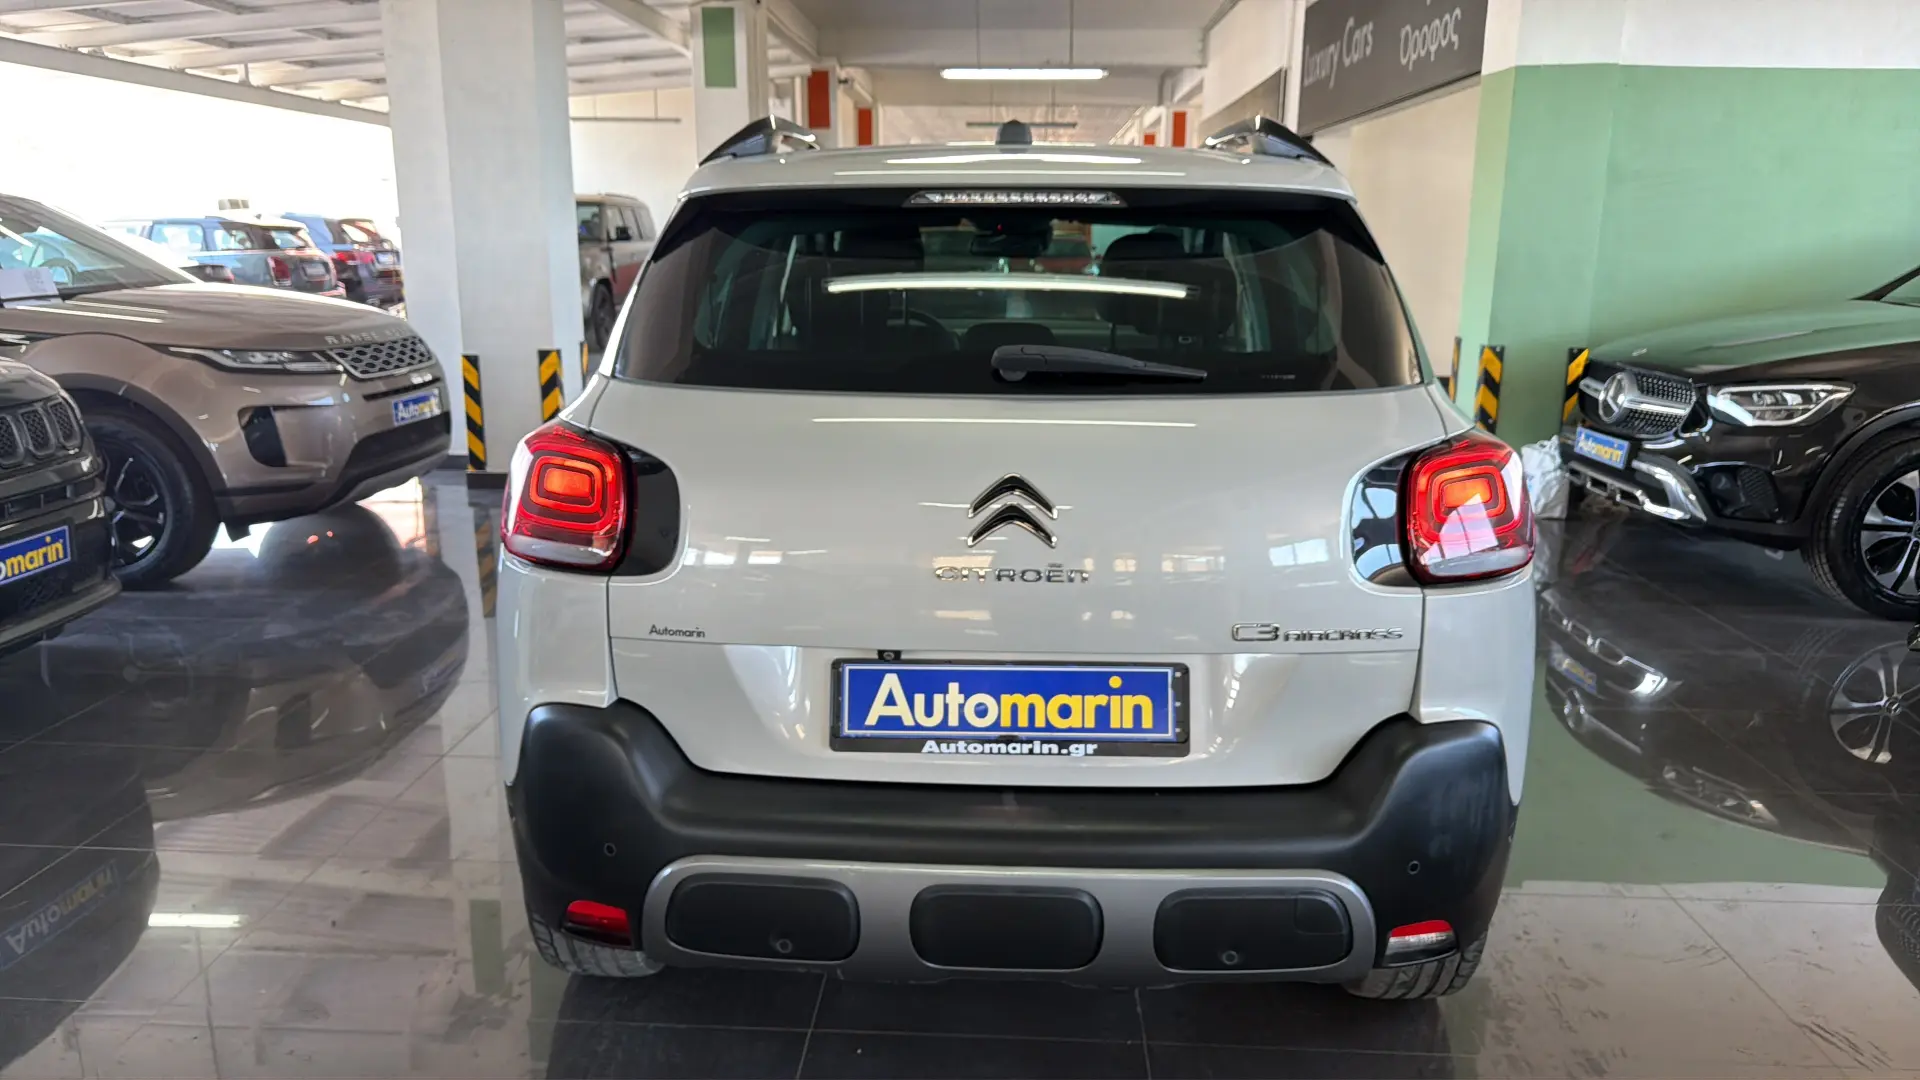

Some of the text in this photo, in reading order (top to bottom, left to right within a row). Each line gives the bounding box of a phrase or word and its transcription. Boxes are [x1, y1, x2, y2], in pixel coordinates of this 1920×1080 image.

[1303, 16, 1374, 91] Luxury Cars
[648, 623, 706, 638] Automarin
[1232, 623, 1403, 642] C3 AIRCROSS
[864, 672, 1154, 729] Automarin
[921, 739, 1098, 757] Automarin.gr
